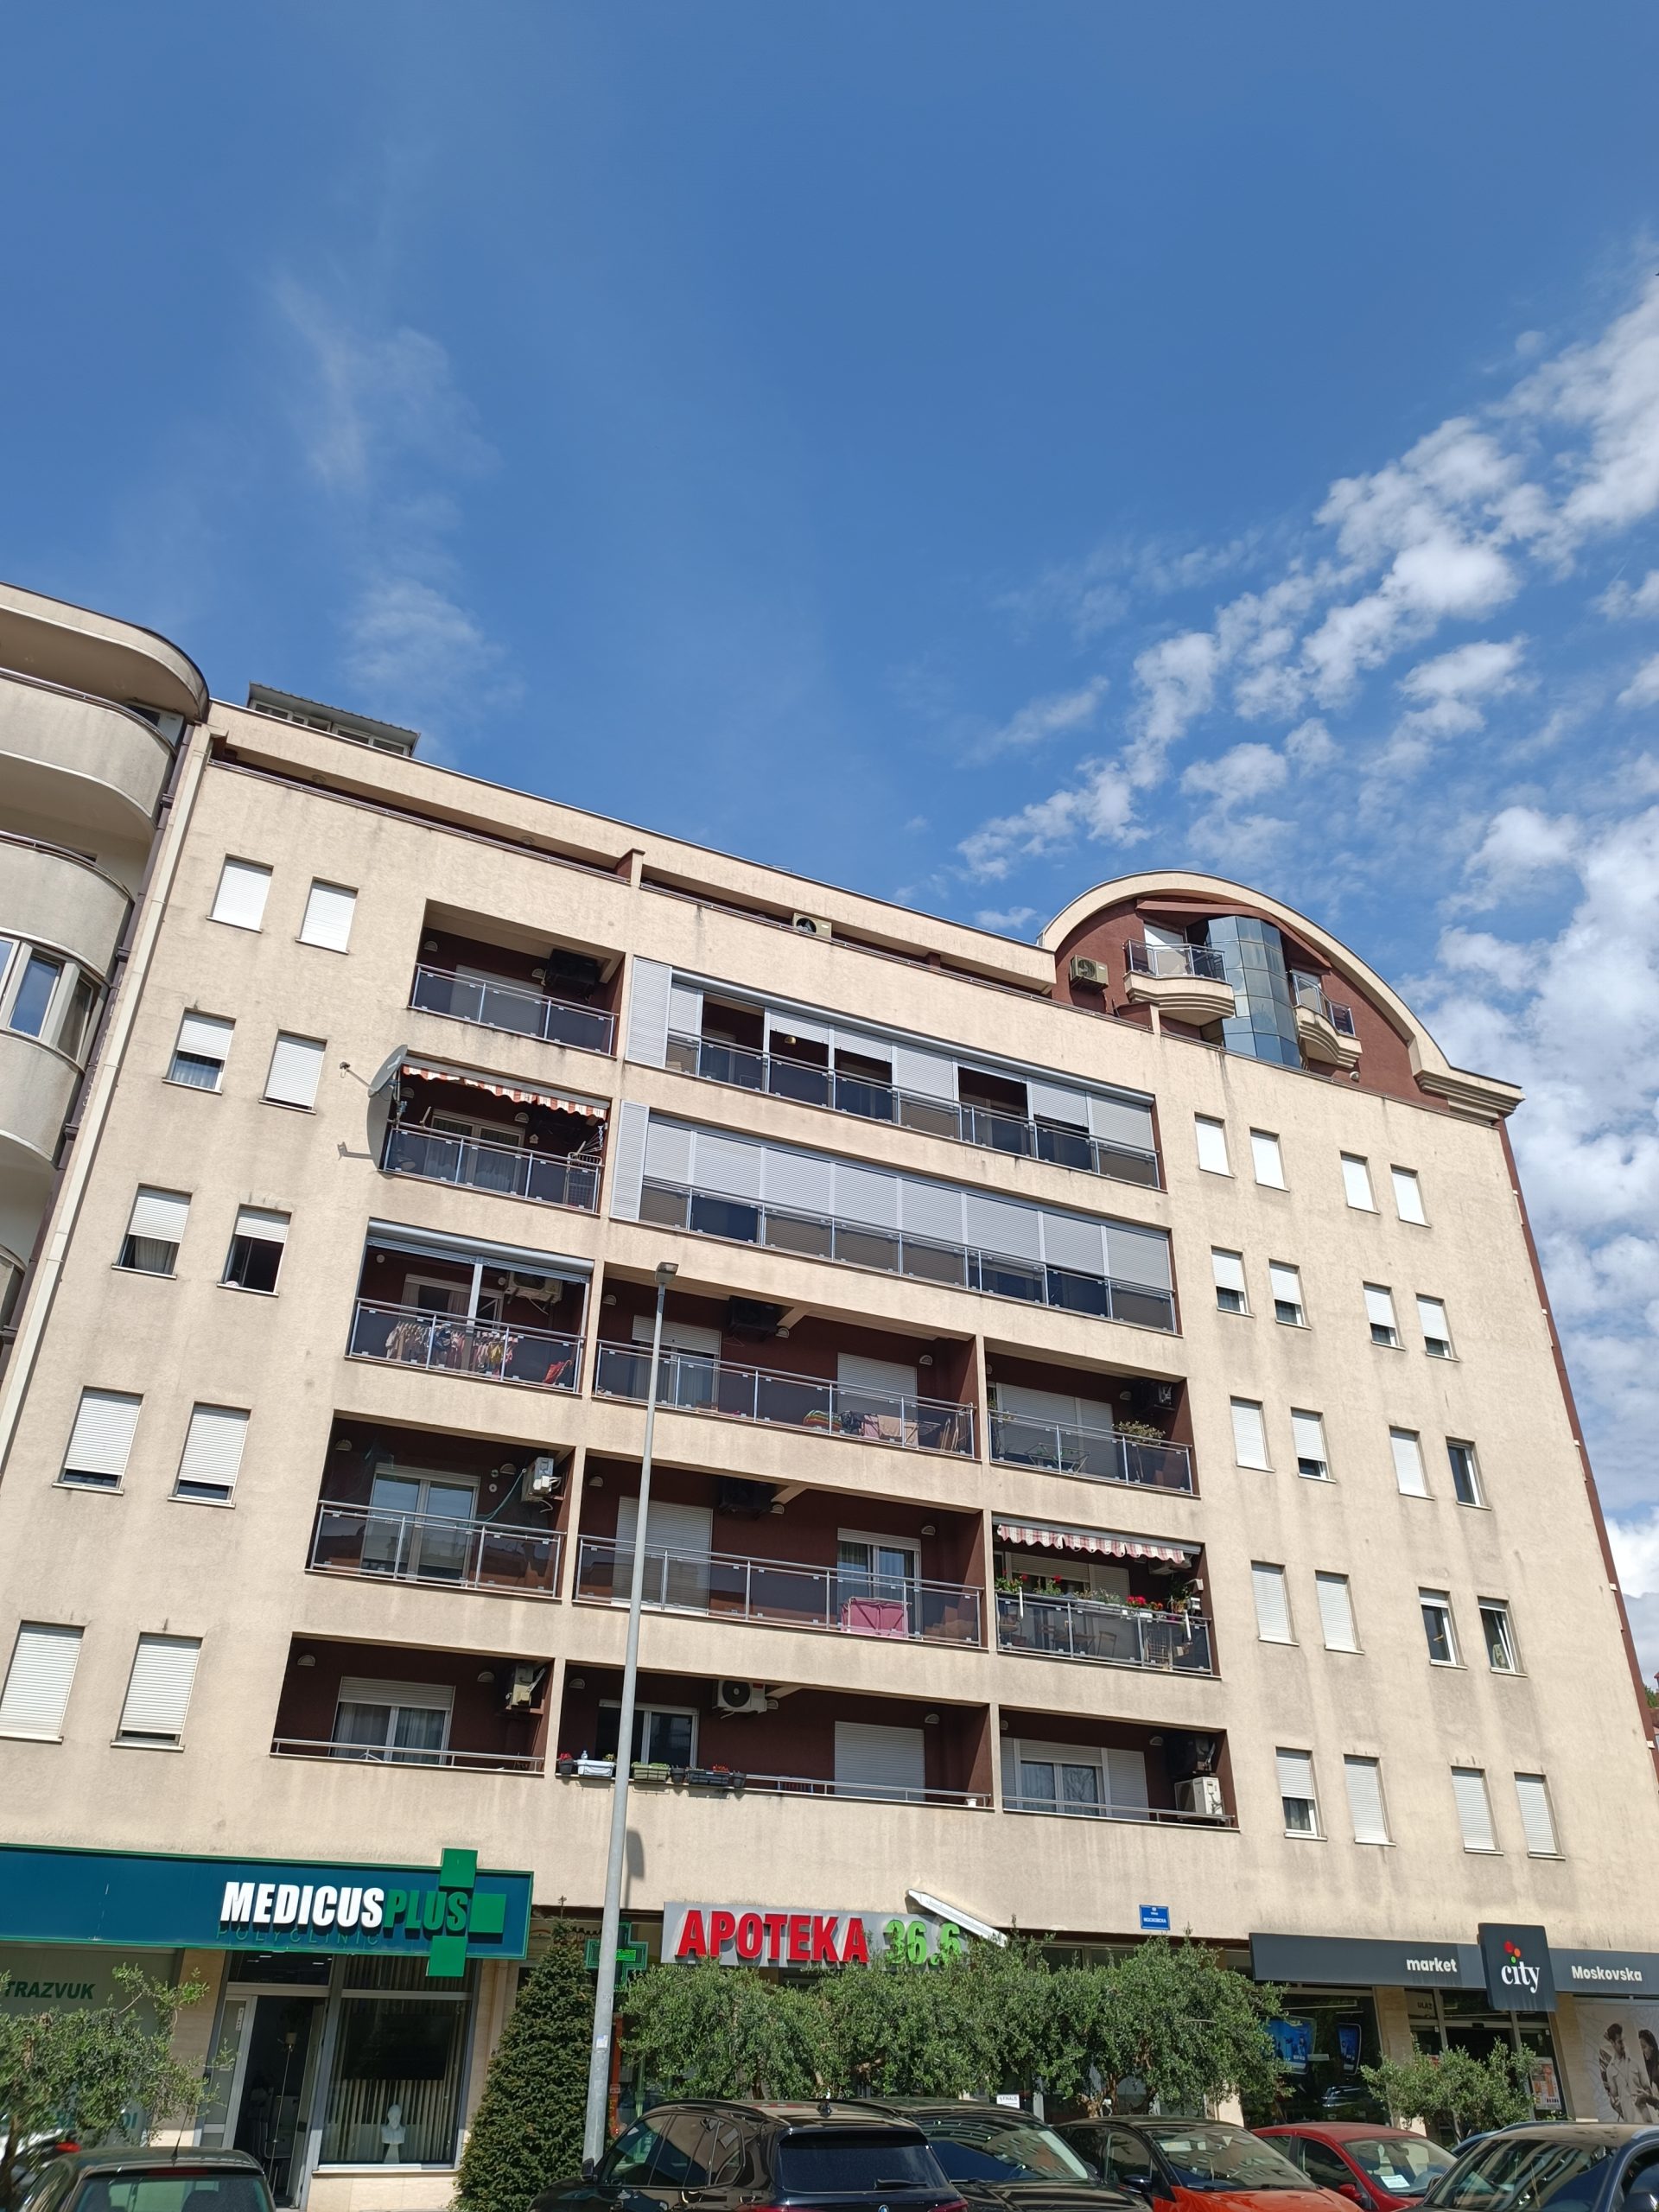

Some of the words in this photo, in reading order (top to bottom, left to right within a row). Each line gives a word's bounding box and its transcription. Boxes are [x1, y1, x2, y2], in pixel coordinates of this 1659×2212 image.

[216, 1926, 380, 1946] POLYCLINIC
[675, 1909, 869, 1964] APOTEKA
[883, 1919, 963, 1967] 36.6
[1406, 1958, 1458, 1973] market
[1571, 1965, 1643, 1982] Moskovska
[1501, 1959, 1541, 1994] city
